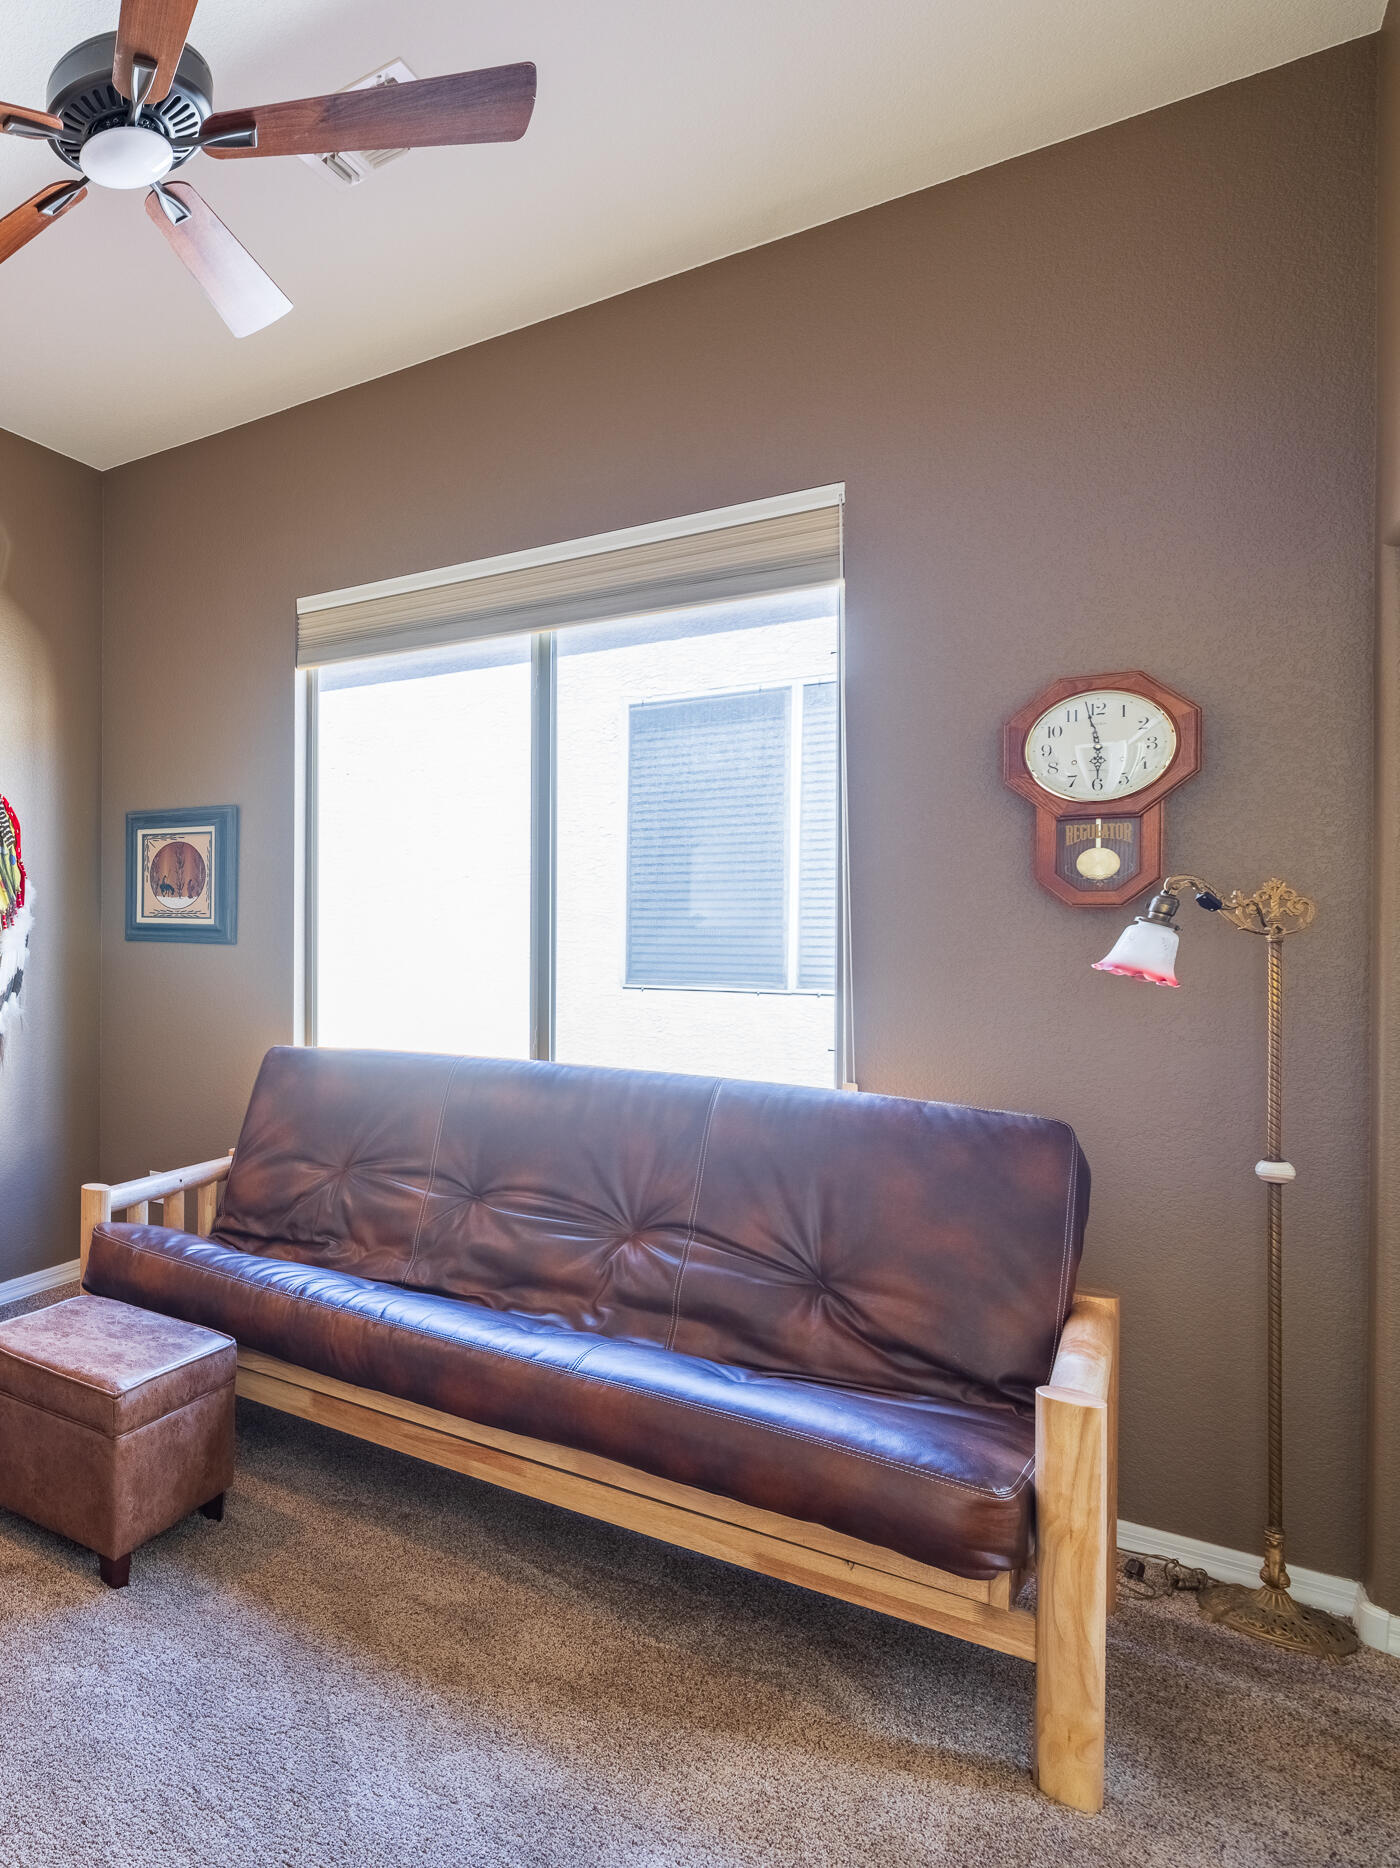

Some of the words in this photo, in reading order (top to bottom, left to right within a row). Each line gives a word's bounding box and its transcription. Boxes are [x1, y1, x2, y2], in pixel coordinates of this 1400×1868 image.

[1066, 709, 1078, 723] 11
[1091, 702, 1107, 716] 12
[1121, 704, 1126, 718] 1
[1137, 716, 1150, 731] 2
[1047, 725, 1063, 739] 10
[1146, 736, 1158, 750] 3
[1041, 744, 1052, 757] 9
[1047, 761, 1059, 775] 8
[1067, 774, 1078, 788] 7
[1091, 778, 1104, 791] 6
[1118, 772, 1130, 785] 5
[1065, 822, 1133, 847] REGULATOR
